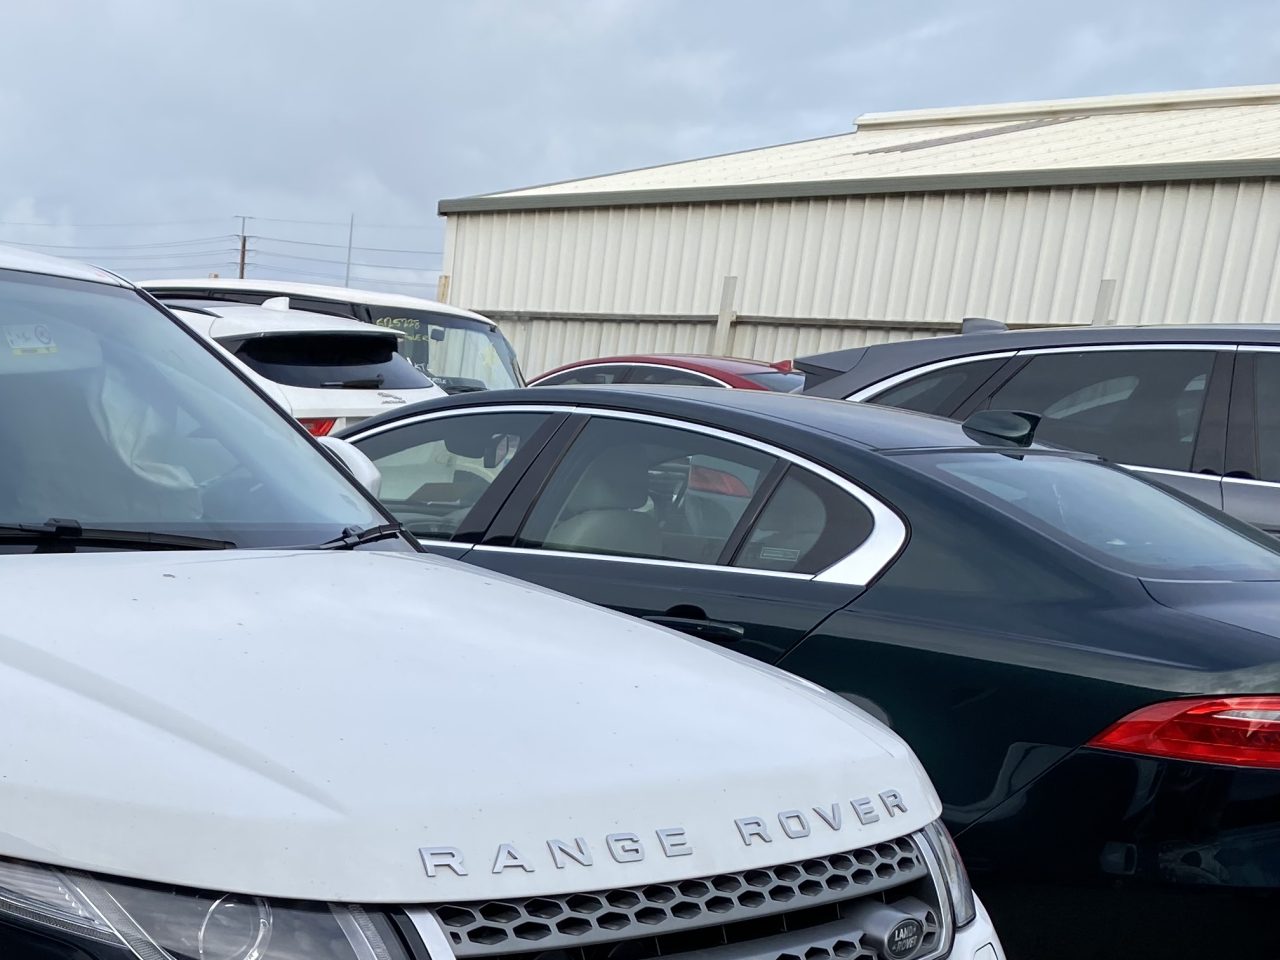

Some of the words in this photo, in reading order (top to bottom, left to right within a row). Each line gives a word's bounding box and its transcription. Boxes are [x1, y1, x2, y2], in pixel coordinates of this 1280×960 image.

[418, 827, 694, 877] RANGE
[734, 789, 908, 846] ROVER
[894, 925, 914, 941] LAND
[895, 936, 918, 952] ROVER
